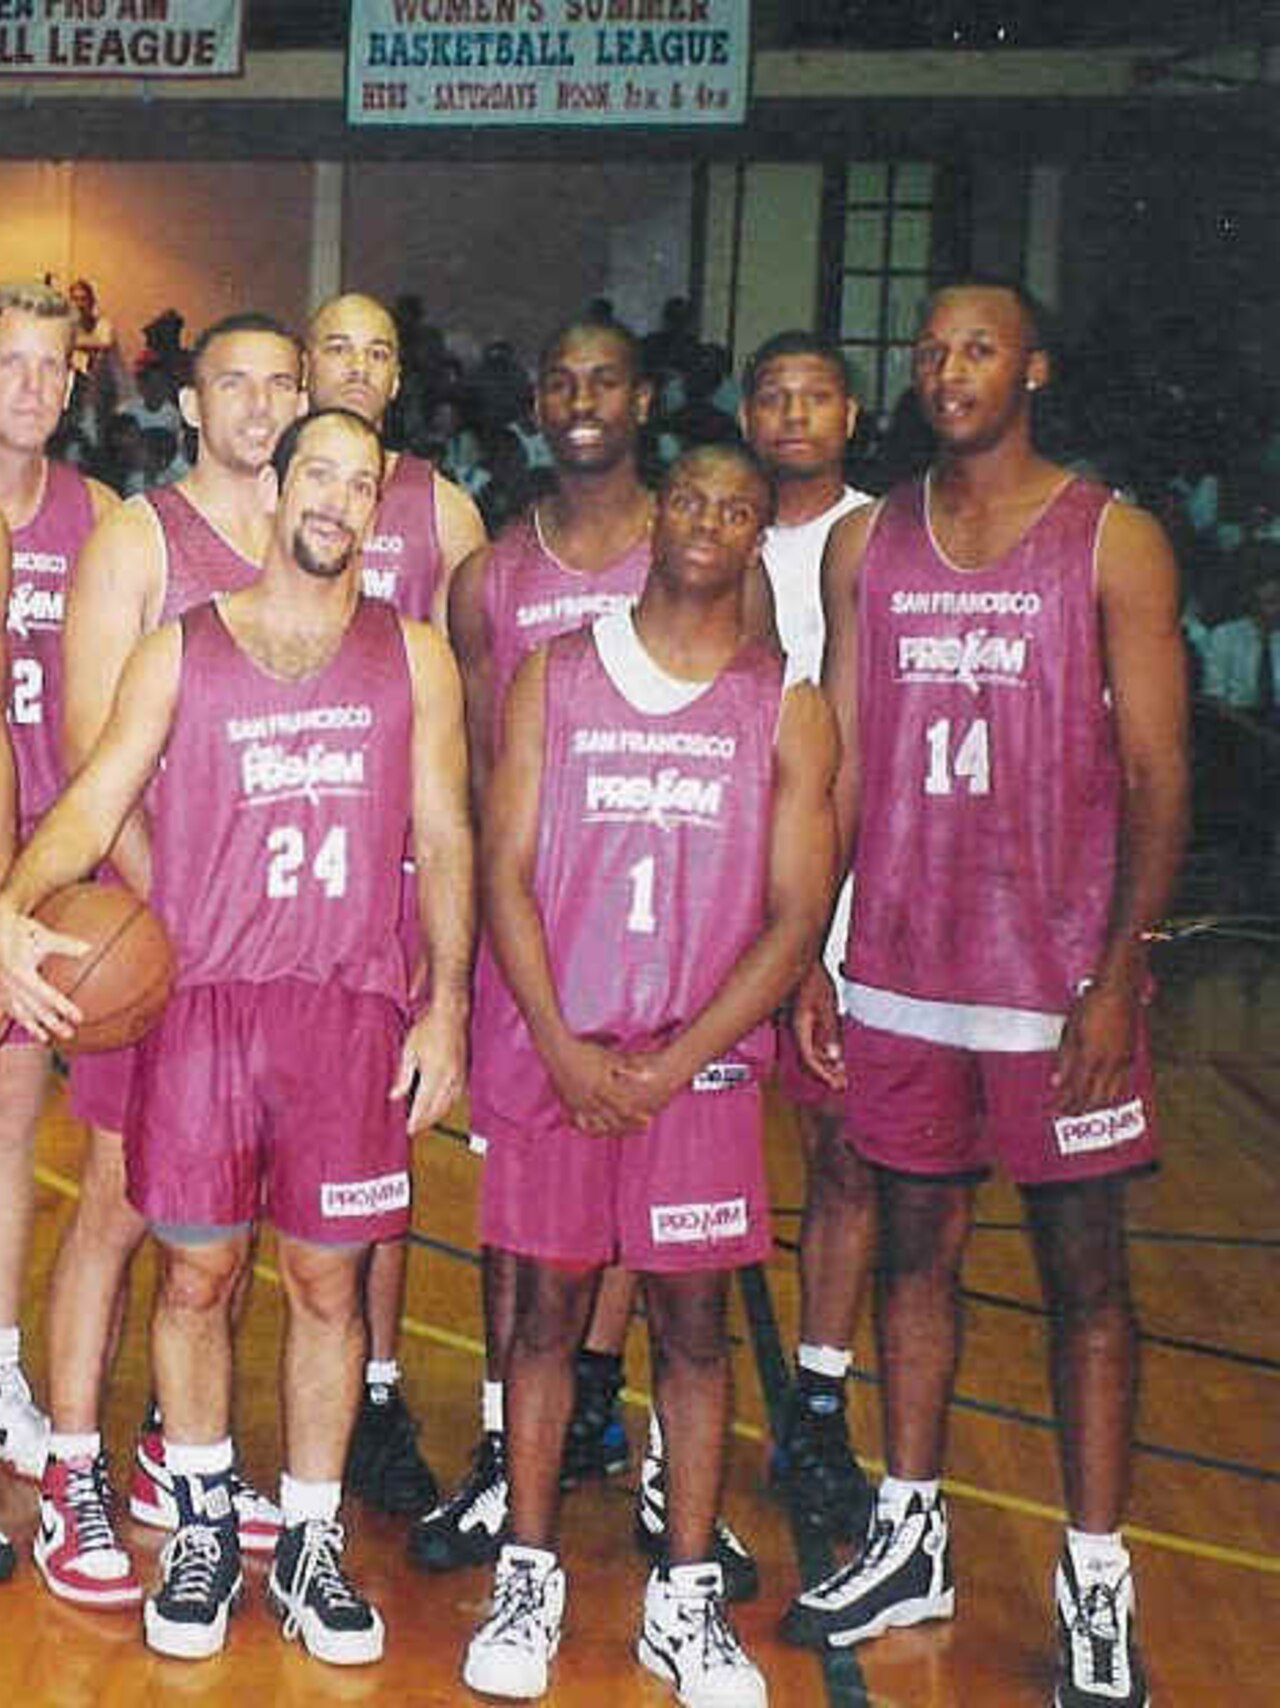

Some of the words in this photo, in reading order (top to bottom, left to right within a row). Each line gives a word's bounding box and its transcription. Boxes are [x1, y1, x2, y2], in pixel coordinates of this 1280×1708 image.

[392, 0, 545, 24] WOMEN'S
[566, 0, 710, 22] SUMMER
[48, 28, 216, 66] LEAGUE
[367, 32, 575, 66] BASKETBALL
[596, 31, 729, 65] LEAGUE
[558, 82, 609, 110] NOON
[889, 591, 931, 614] SAN
[931, 592, 1041, 614] FRANCISCO
[573, 730, 619, 753] SAN
[621, 731, 736, 759] FRANCISCO
[924, 717, 990, 795] 14
[267, 825, 347, 898] 24
[628, 855, 656, 934] 1
